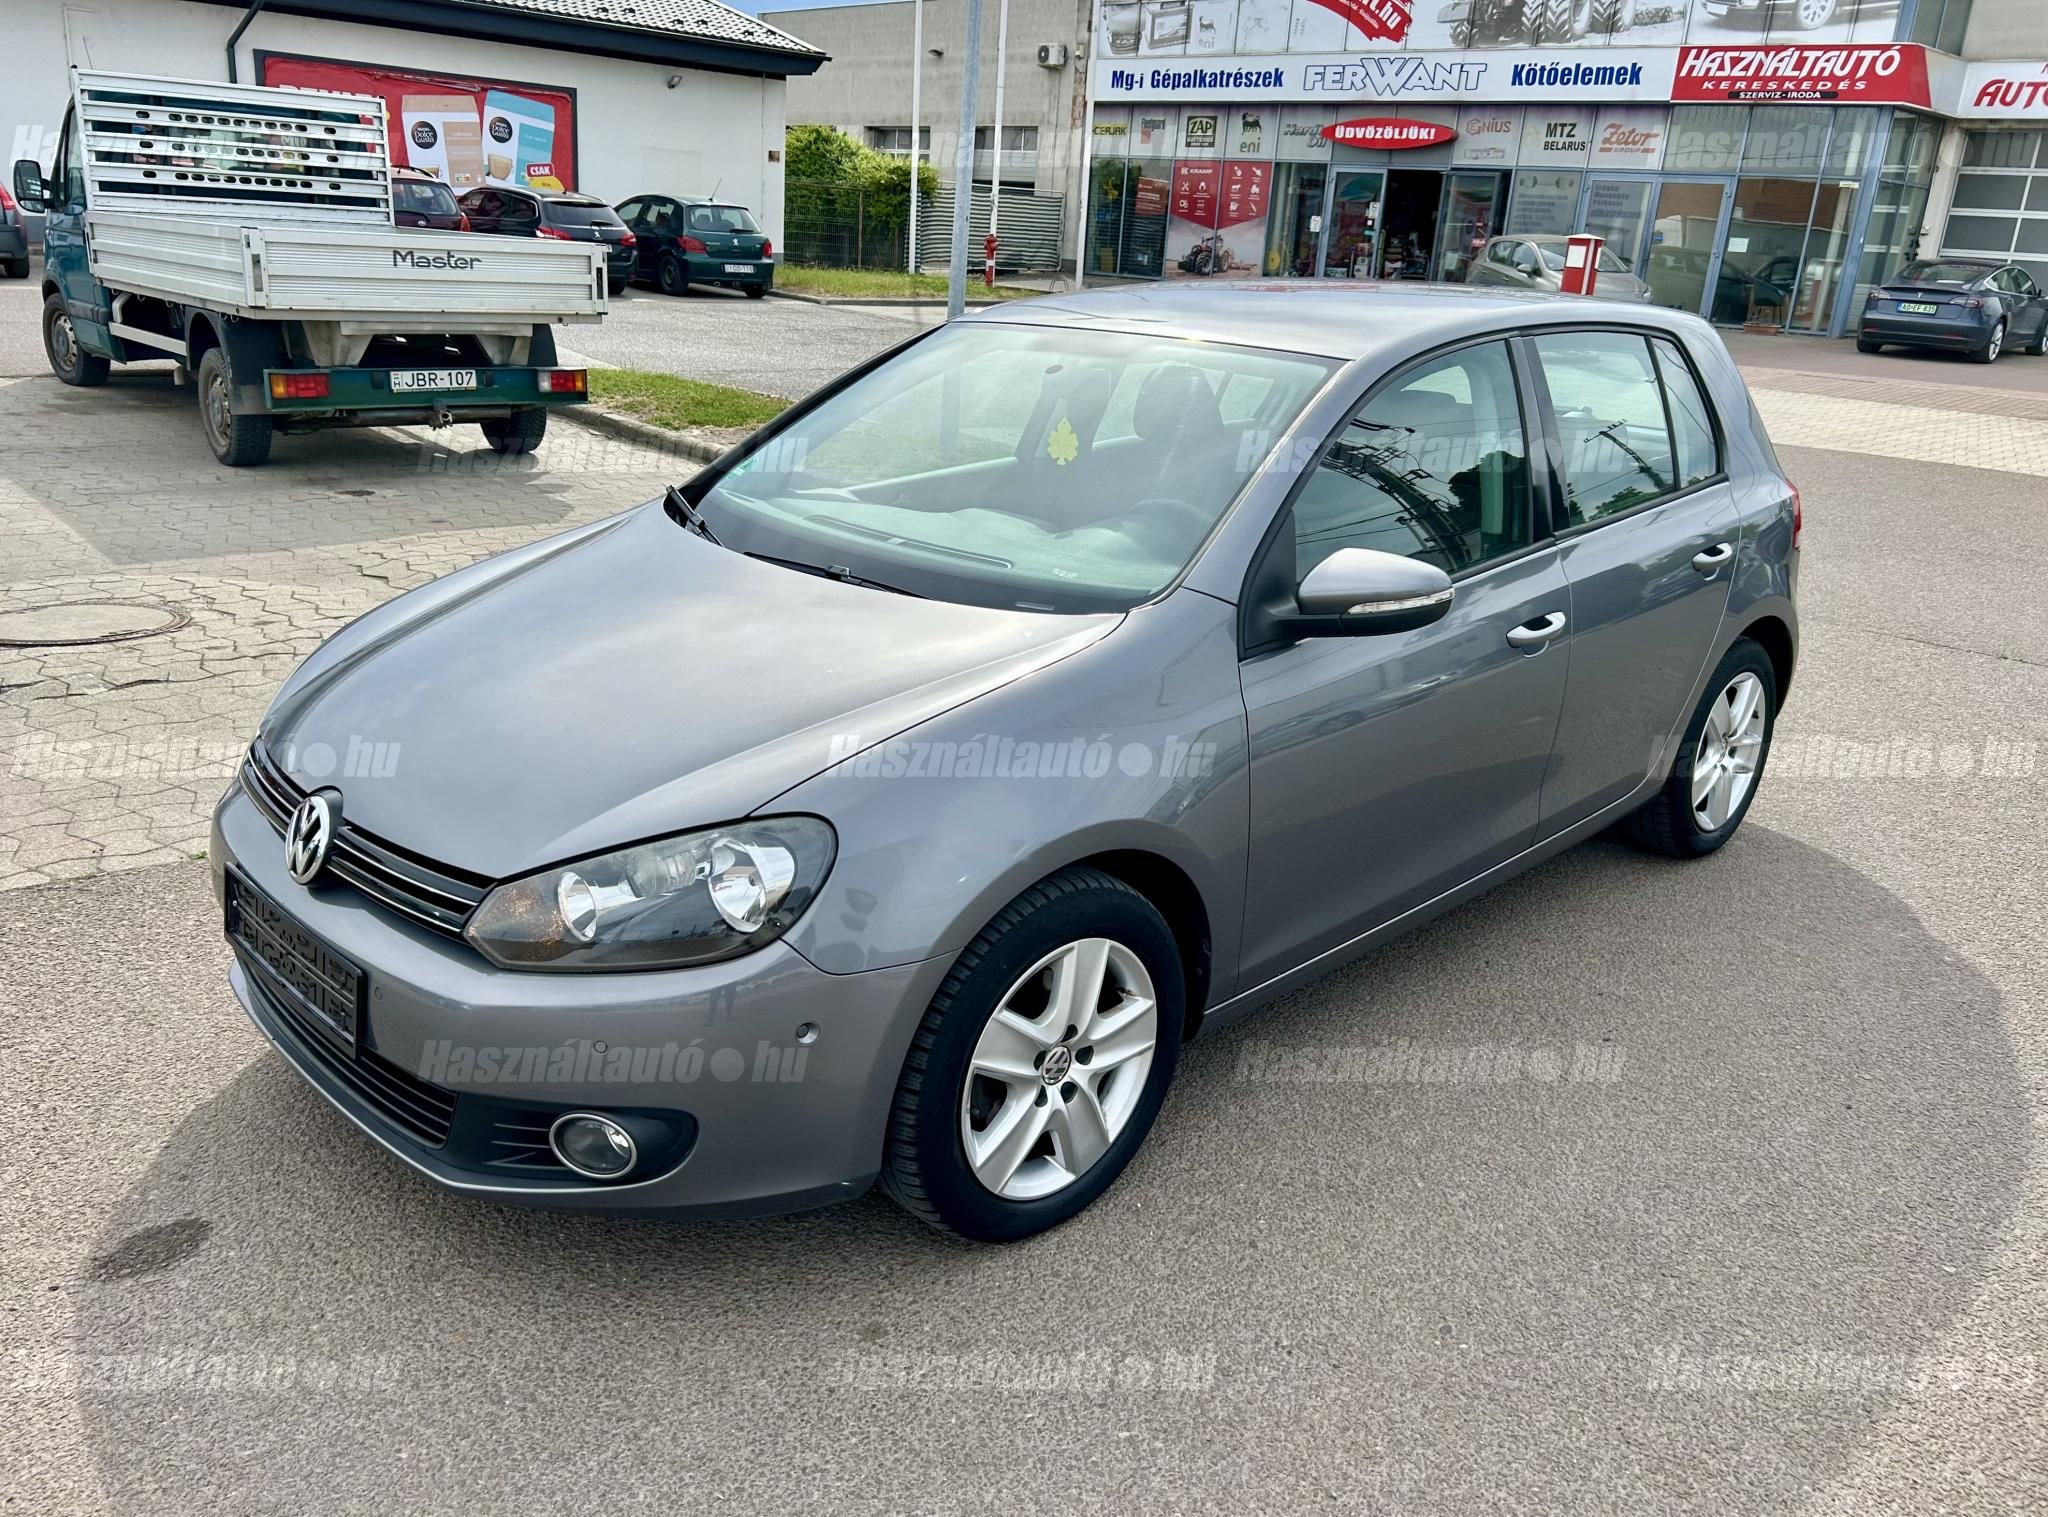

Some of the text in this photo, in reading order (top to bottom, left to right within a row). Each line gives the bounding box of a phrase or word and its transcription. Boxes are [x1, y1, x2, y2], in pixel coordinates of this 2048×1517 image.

[1680, 45, 1902, 80] HASZNÁLTAUTÓ
[1111, 68, 1285, 90] Mg-i Gépalkatrészek
[1511, 62, 1643, 87] Kötőelemek
[1701, 78, 1868, 90] KERESKEDÉS
[1189, 119, 1213, 134] ZAP
[1334, 125, 1436, 140] ÜDVÖZÖLJÜK!
[1545, 122, 1578, 138] MTZ
[1602, 122, 1660, 146] Zetor
[1239, 137, 1262, 153] eni
[1543, 140, 1586, 151] BELARUS
[530, 166, 551, 176] CSAK
[393, 250, 483, 269] Master
[405, 371, 474, 388] JBR-107
